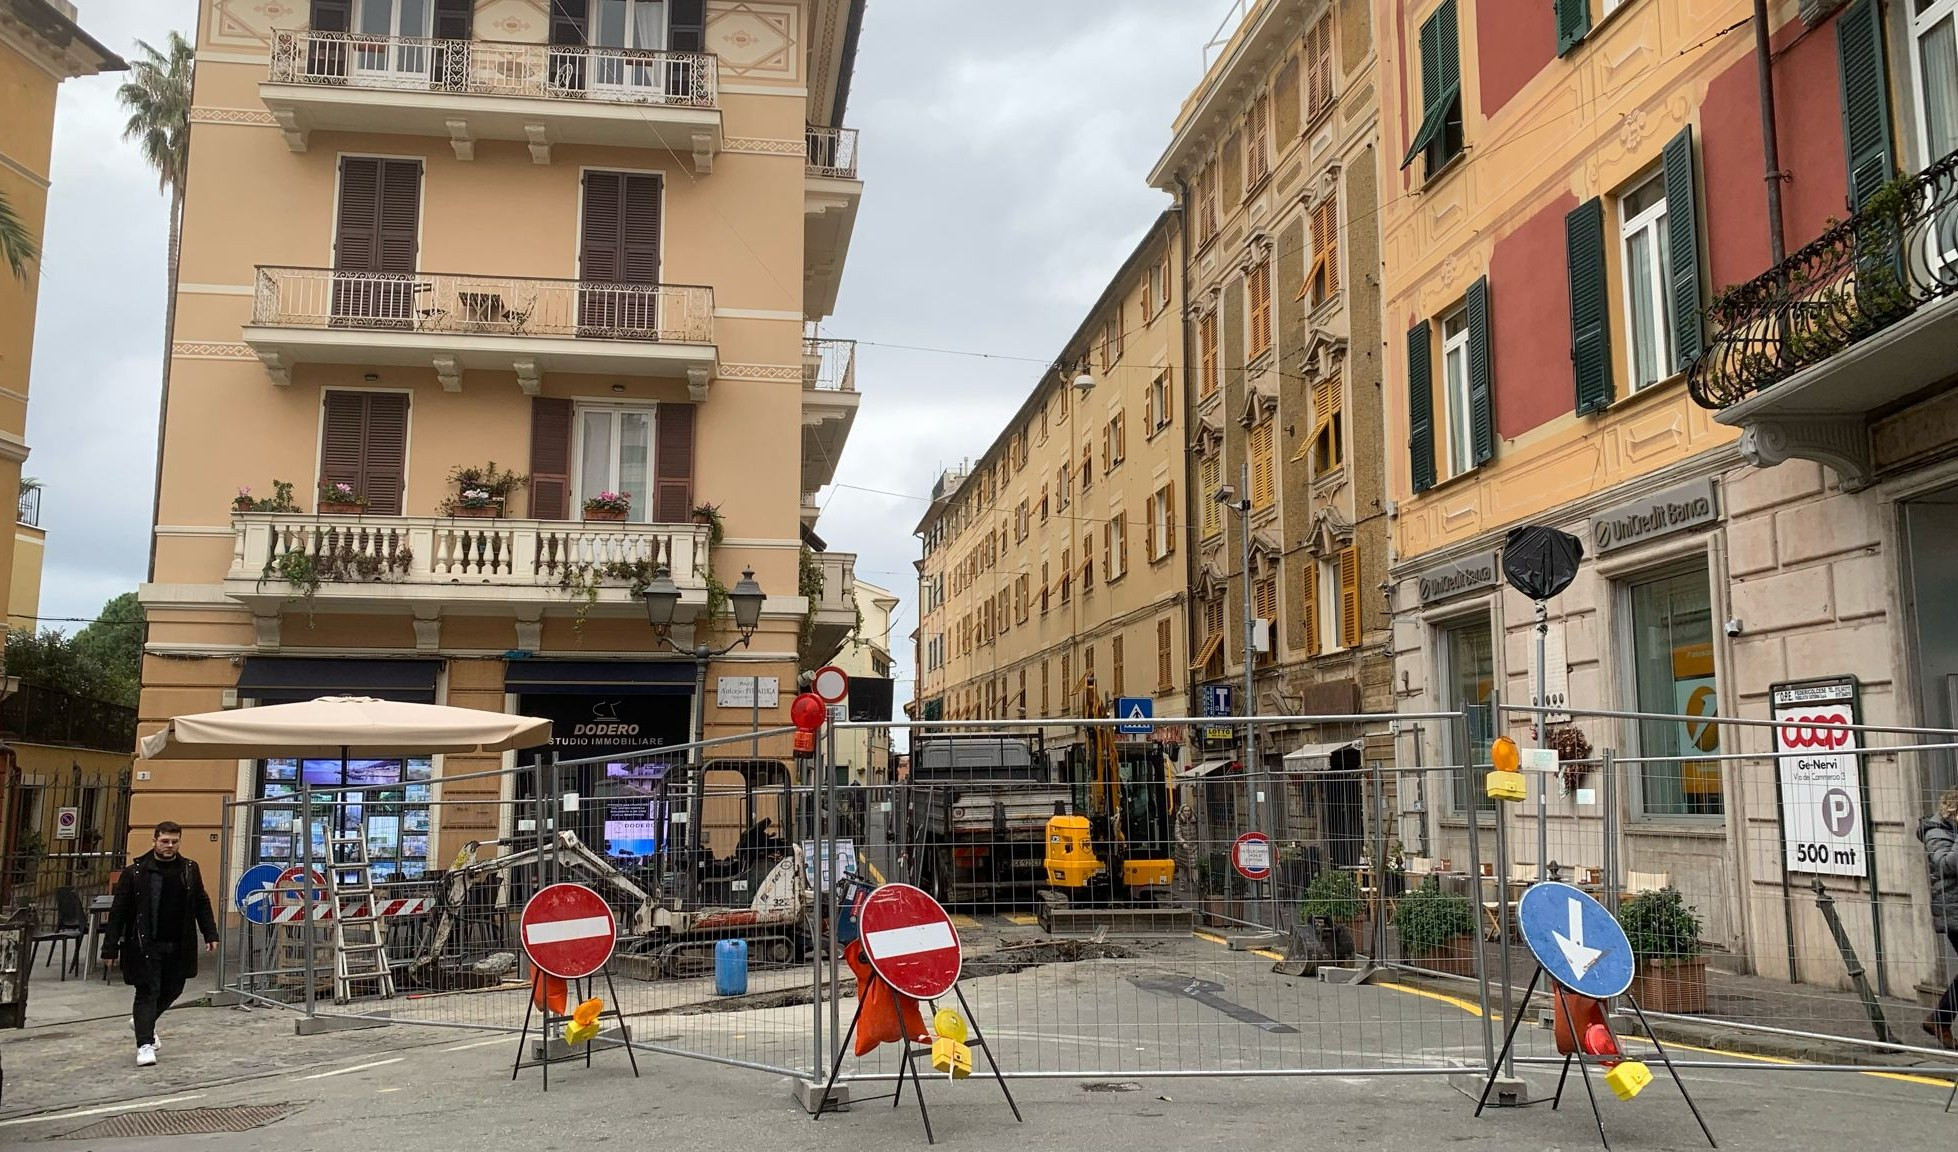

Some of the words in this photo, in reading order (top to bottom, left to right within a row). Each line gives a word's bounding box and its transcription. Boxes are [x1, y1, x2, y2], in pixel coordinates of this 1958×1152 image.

[1613, 505, 1667, 540] UniCredit
[1666, 497, 1709, 525] Banca
[1215, 688, 1228, 712] T
[549, 737, 588, 746] STUDIO
[591, 737, 664, 746] IMMOBILIARE
[574, 724, 640, 736] DODERO
[1781, 713, 1849, 751] coop
[1798, 758, 1838, 770] Ge-Nervi
[1829, 794, 1850, 832] P
[1797, 843, 1829, 864] 500
[1834, 848, 1856, 865] mt
